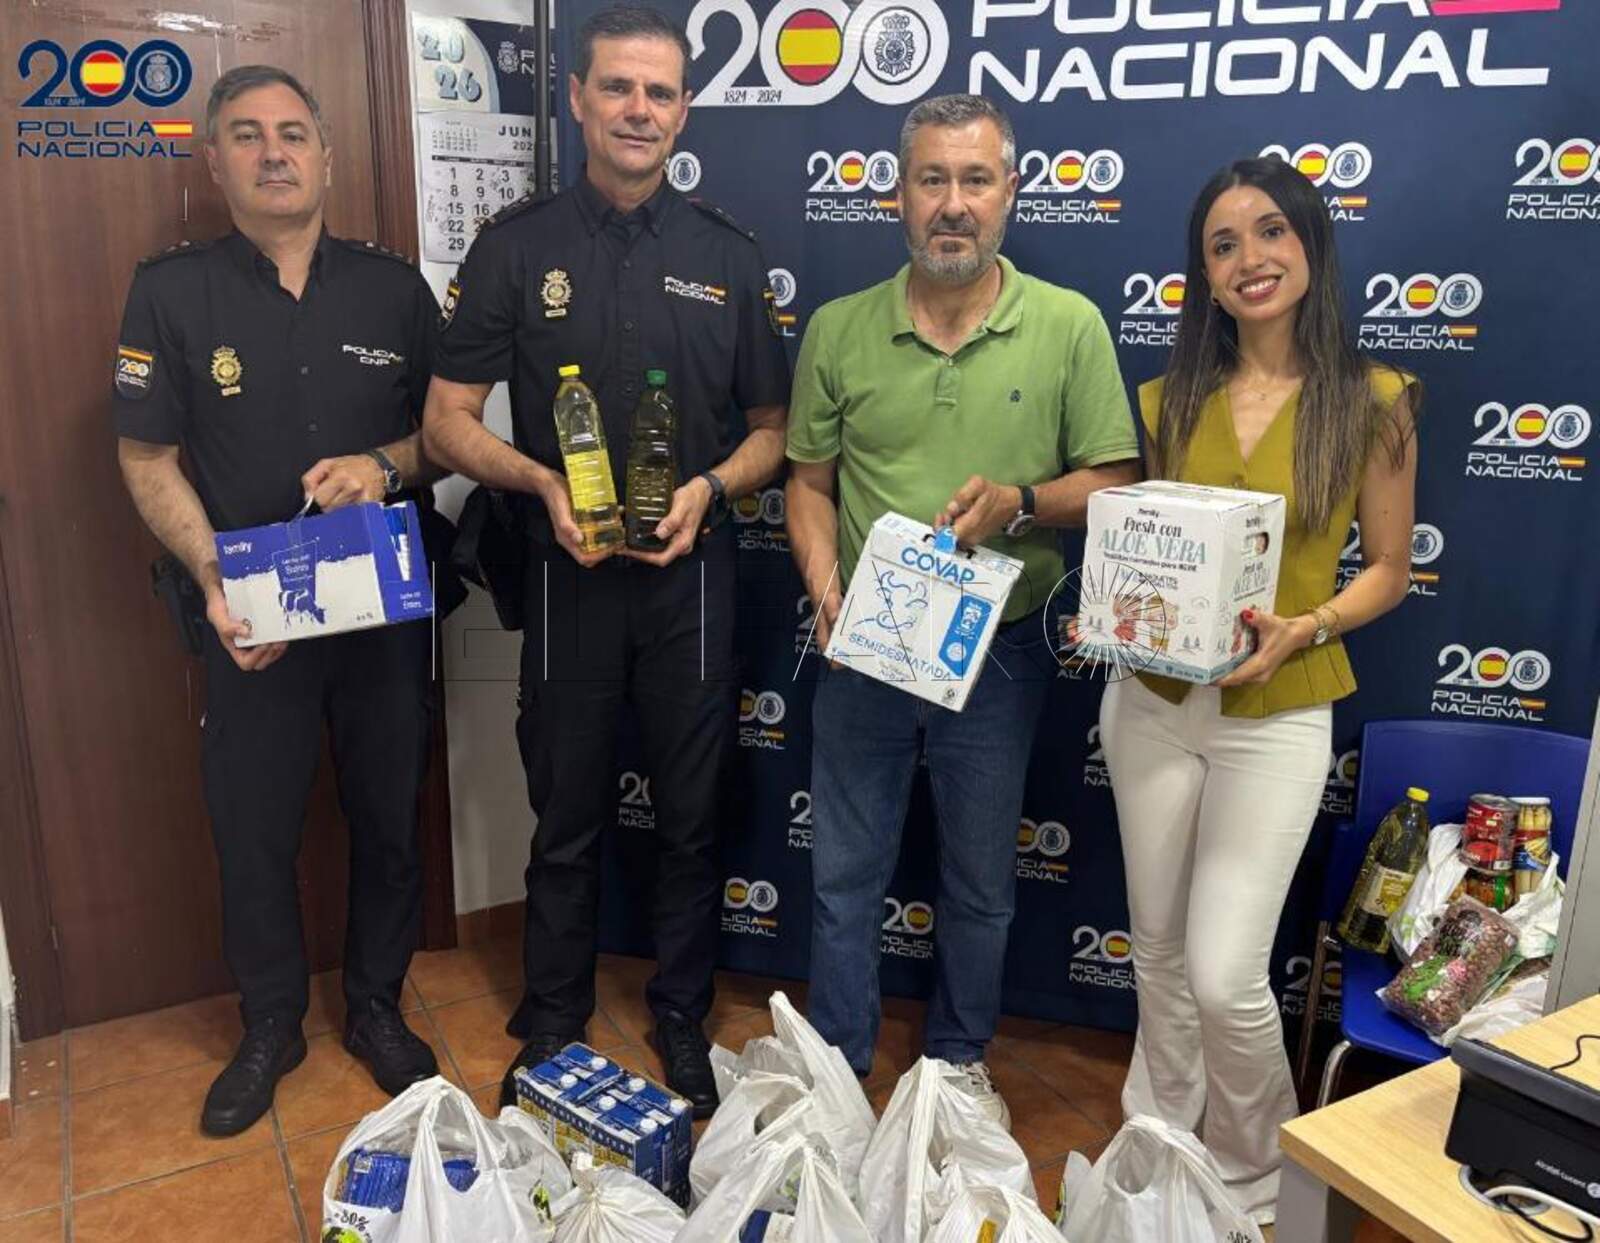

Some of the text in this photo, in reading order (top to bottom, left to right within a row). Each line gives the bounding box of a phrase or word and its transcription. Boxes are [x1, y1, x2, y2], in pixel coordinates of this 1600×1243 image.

[969, 28, 1549, 102] NACIONAL
[498, 125, 532, 138] JUN
[512, 141, 533, 151] 202
[1512, 138, 1600, 186] 20
[475, 168, 484, 181] 2
[501, 170, 510, 182] 3
[1017, 149, 1124, 193] 200
[450, 185, 515, 200] 8 9 10
[448, 202, 490, 216] 15 16
[805, 199, 880, 210] POLICIA
[1017, 200, 1099, 211] POLICIA
[805, 211, 899, 223] NACIONAL
[1016, 212, 1120, 223] NACIONAL
[1506, 207, 1600, 220] NACION
[448, 219, 464, 233] 22
[448, 237, 465, 250] 29
[1123, 272, 1187, 315] 20
[1362, 273, 1483, 318] 200
[1120, 321, 1180, 333] POLIC
[1359, 324, 1451, 337] POLICIA
[1357, 338, 1475, 350] NACIONAL
[1471, 401, 1592, 449] 200
[1467, 452, 1560, 467] POLICIA
[1465, 465, 1583, 481] NACIONAL
[1123, 517, 1182, 538] Fresh con
[1099, 528, 1206, 565] ALOE VERA
[901, 546, 975, 584] COVAP
[847, 631, 951, 681] SEMIDESNATADA
[1436, 644, 1551, 691] 200
[1432, 690, 1521, 707] POLICIA
[1430, 702, 1545, 721] NACIONAL
[739, 737, 785, 750] ONAL
[1016, 868, 1069, 883] ONAL
[1072, 925, 1134, 963] 20
[1070, 962, 1133, 980] POLICI
[1069, 972, 1136, 990] NACION
